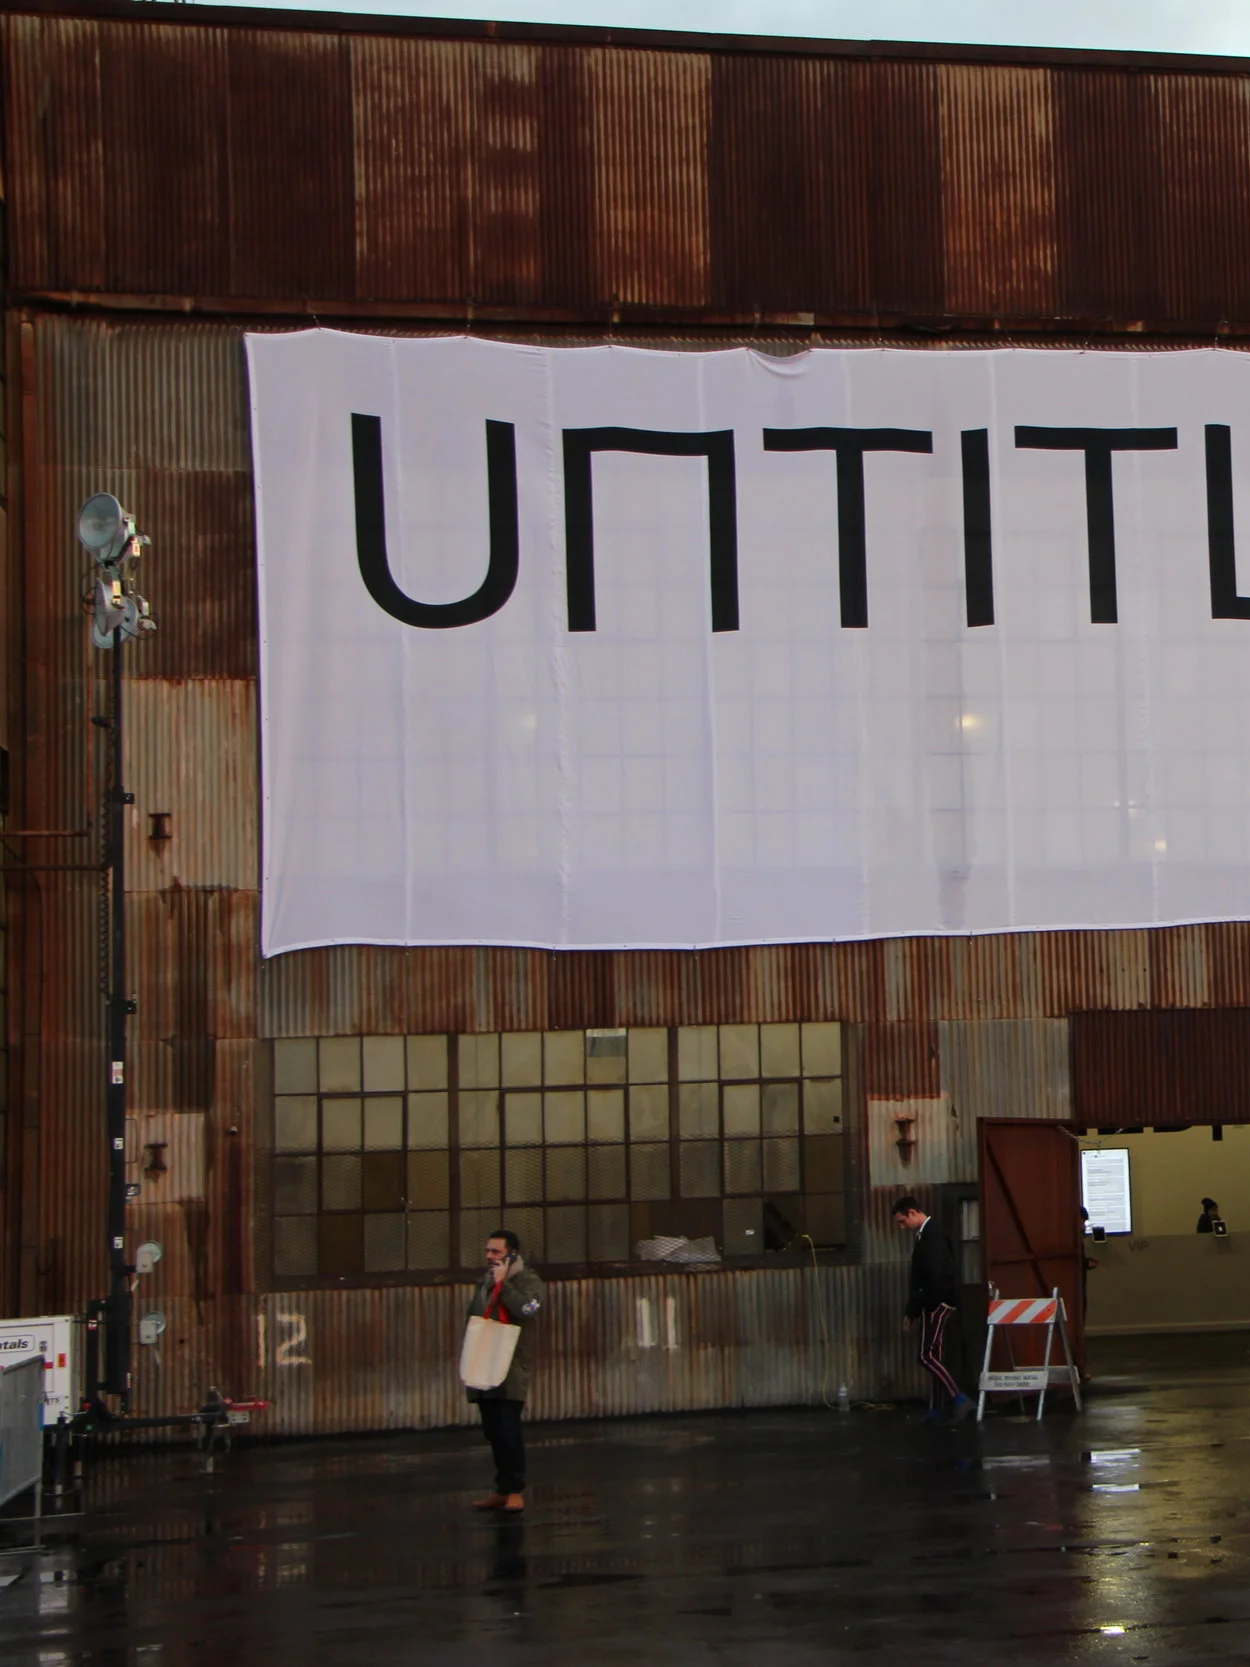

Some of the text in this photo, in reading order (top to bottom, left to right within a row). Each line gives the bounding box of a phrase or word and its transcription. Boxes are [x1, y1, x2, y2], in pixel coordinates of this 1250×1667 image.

[1127, 1239, 1150, 1253] VIP
[256, 1312, 312, 1369] 12
[635, 1296, 678, 1350] 11
